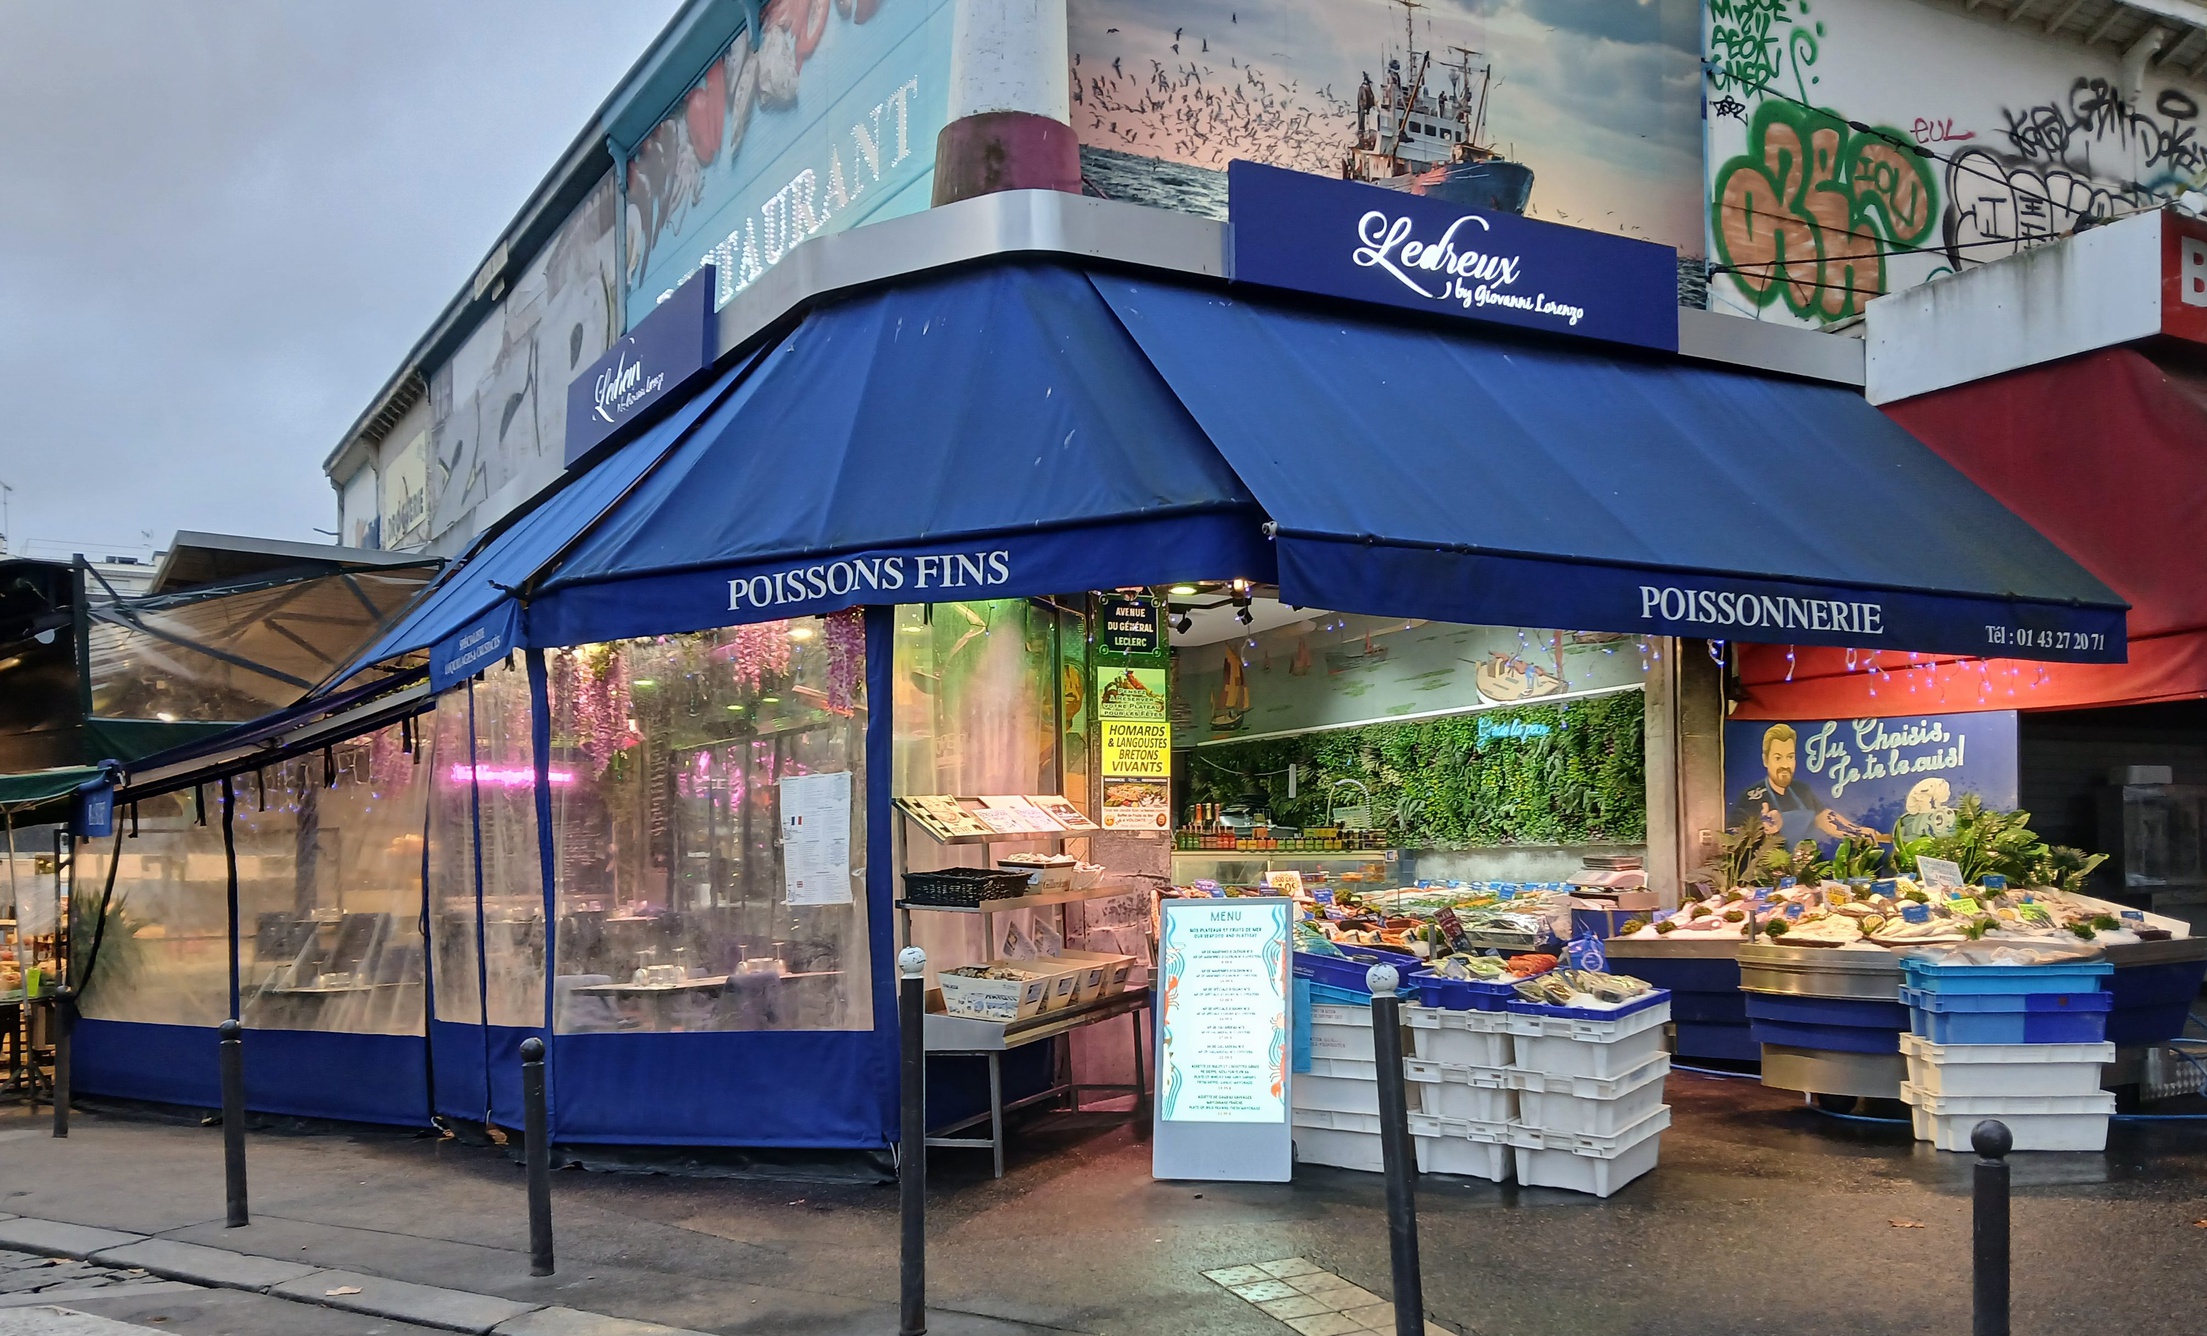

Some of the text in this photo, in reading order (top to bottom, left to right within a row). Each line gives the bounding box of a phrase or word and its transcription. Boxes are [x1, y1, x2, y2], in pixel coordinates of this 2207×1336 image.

[657, 74, 919, 304] TAURANT
[1352, 211, 1521, 299] Ledreux
[1455, 277, 1584, 326] by Giovanni Lorenzo
[727, 550, 1010, 611] POISSONS FINS
[1115, 607, 1146, 617] AVENUE
[1639, 585, 1885, 634] POISSONNERIE
[1107, 620, 1154, 633] DU GÉNÉRAL
[1114, 636, 1147, 647] LECLERC
[1985, 625, 2006, 644] Tél
[2016, 628, 2033, 647] 01
[2037, 630, 2053, 648] 43
[2055, 632, 2071, 649] 27
[2073, 632, 2089, 650] 20
[2091, 633, 2105, 651] 71
[1109, 725, 1165, 736] HOMARDS
[1108, 737, 1168, 748] & LANGOUSTES
[1805, 718, 1950, 773] Tu Choisis,
[1119, 749, 1159, 760] BRETONS
[1112, 761, 1163, 772] VIVANTS
[1829, 755, 1861, 798] Je
[1862, 754, 1887, 780] te
[1888, 749, 1910, 776] le
[1210, 911, 1242, 921] MENU
